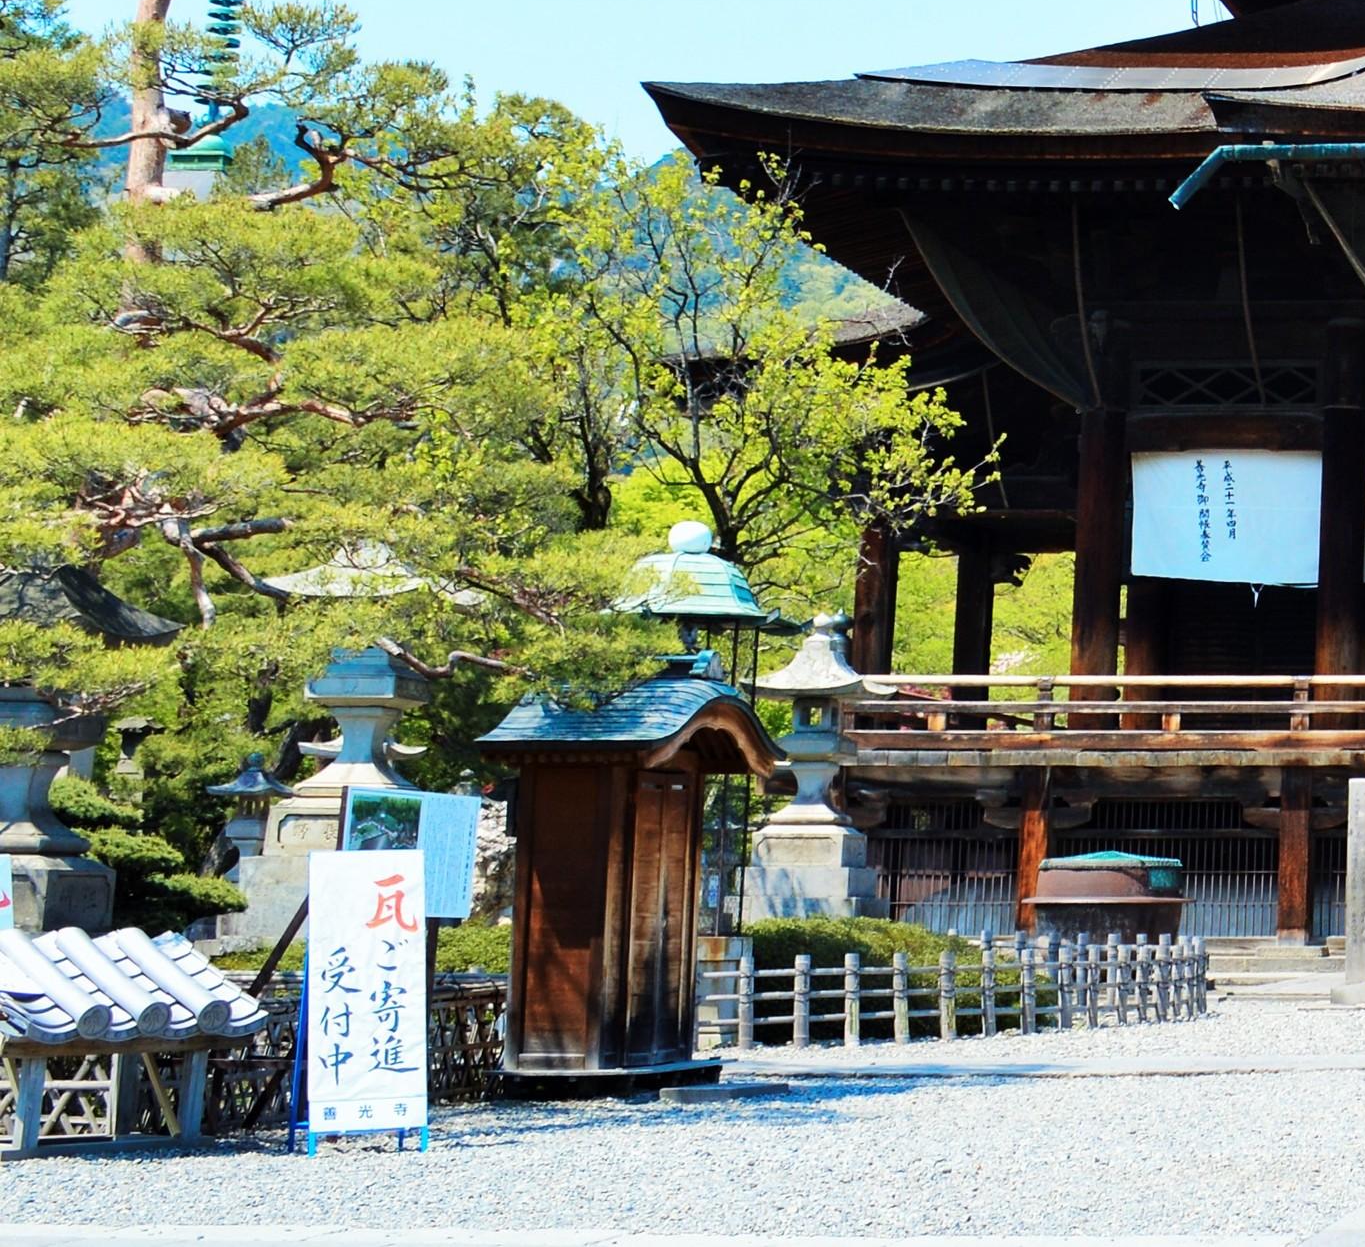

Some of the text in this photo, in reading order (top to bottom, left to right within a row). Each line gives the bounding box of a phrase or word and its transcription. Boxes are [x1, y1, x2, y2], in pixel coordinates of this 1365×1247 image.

[1222, 459, 1237, 540] 平成二十一年四月
[319, 946, 362, 1086] 受付中
[365, 873, 420, 1074] 瓦ご寄進
[323, 1102, 409, 1121] 善光寺
